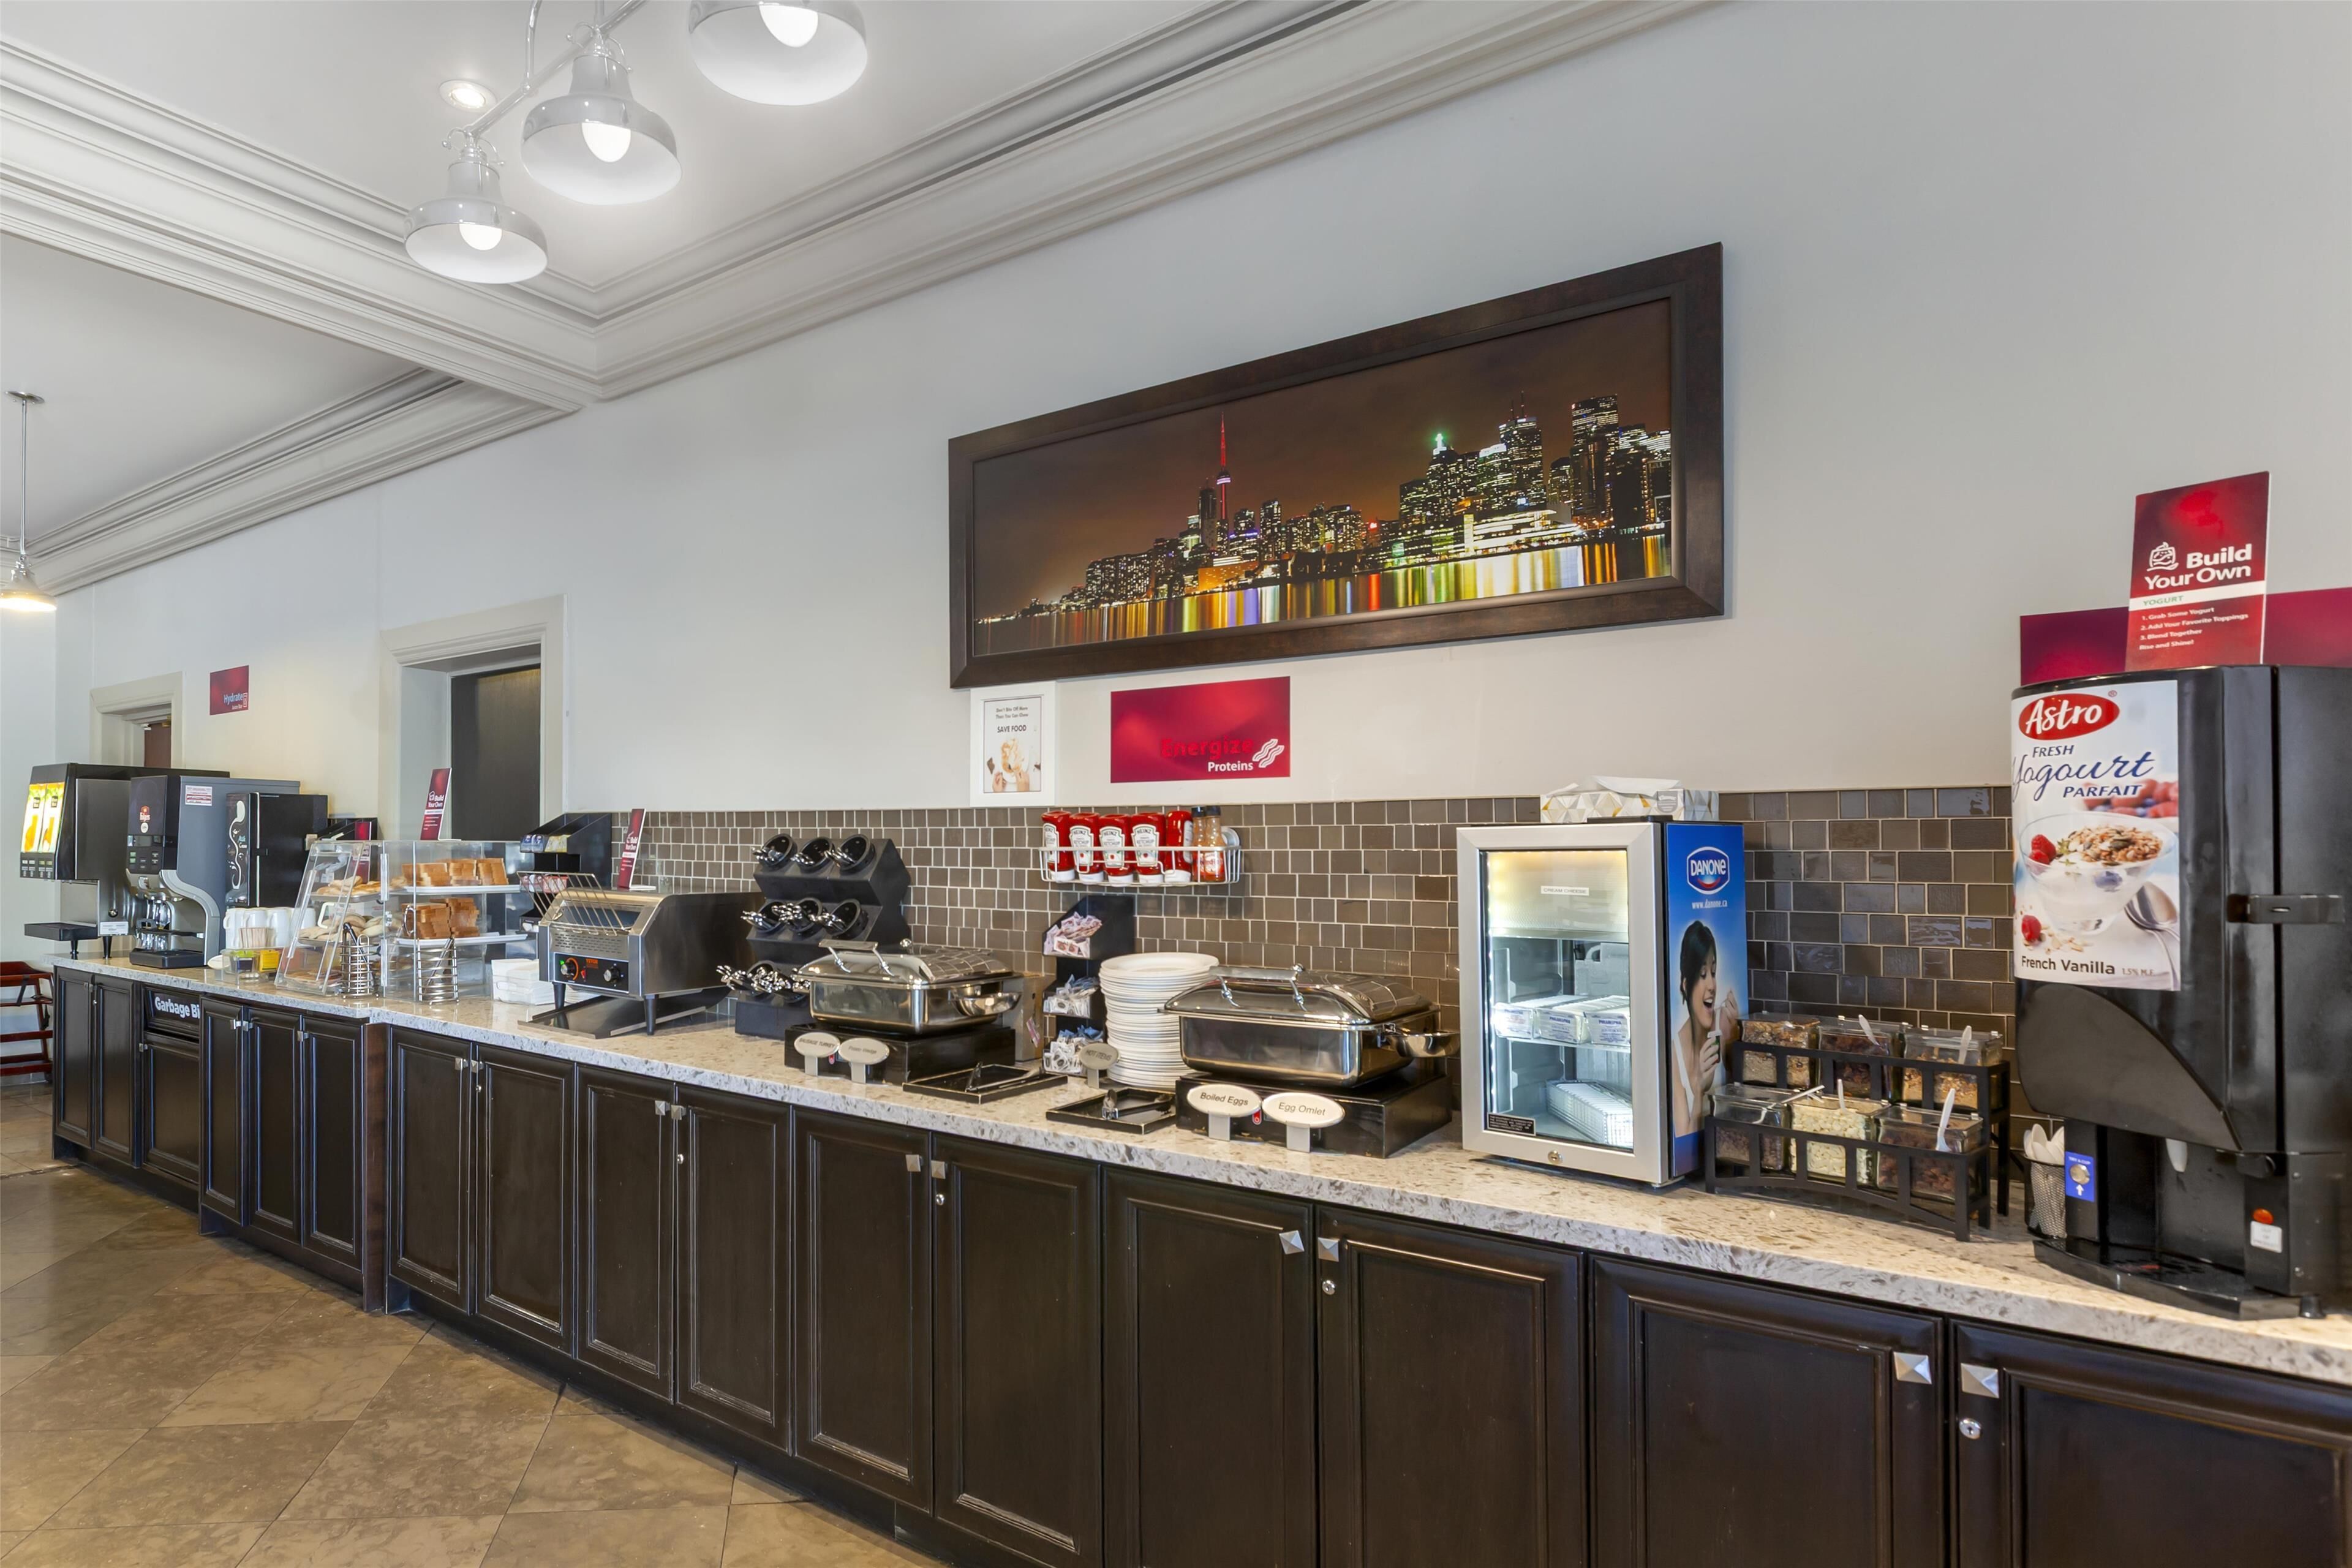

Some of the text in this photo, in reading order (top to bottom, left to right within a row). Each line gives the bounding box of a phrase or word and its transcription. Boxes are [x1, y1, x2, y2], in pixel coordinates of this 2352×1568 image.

[2187, 543, 2252, 568] Build
[2144, 565, 2252, 590] Your Own
[2143, 595, 2184, 606] YOGURT
[2189, 607, 2215, 616] Yogurt
[2182, 617, 2212, 626] Favorite
[2213, 614, 2249, 622] Toppings
[224, 693, 243, 705] Hydrate
[2025, 699, 2102, 735] Astro
[1161, 736, 1254, 760] Energize
[2032, 744, 2075, 758] FRESH
[1207, 761, 1254, 772] Proteins
[2013, 752, 2155, 802] Yogourt
[2062, 785, 2143, 798] PARFAIT
[1692, 899, 1728, 910] www.danone.ca
[2022, 956, 2056, 970] French
[2060, 959, 2115, 974] Vanilla
[155, 996, 190, 1018] Garbage
[1200, 1092, 1248, 1106] Boiled Eggs
[1278, 1102, 1325, 1116] Egg Omlet
